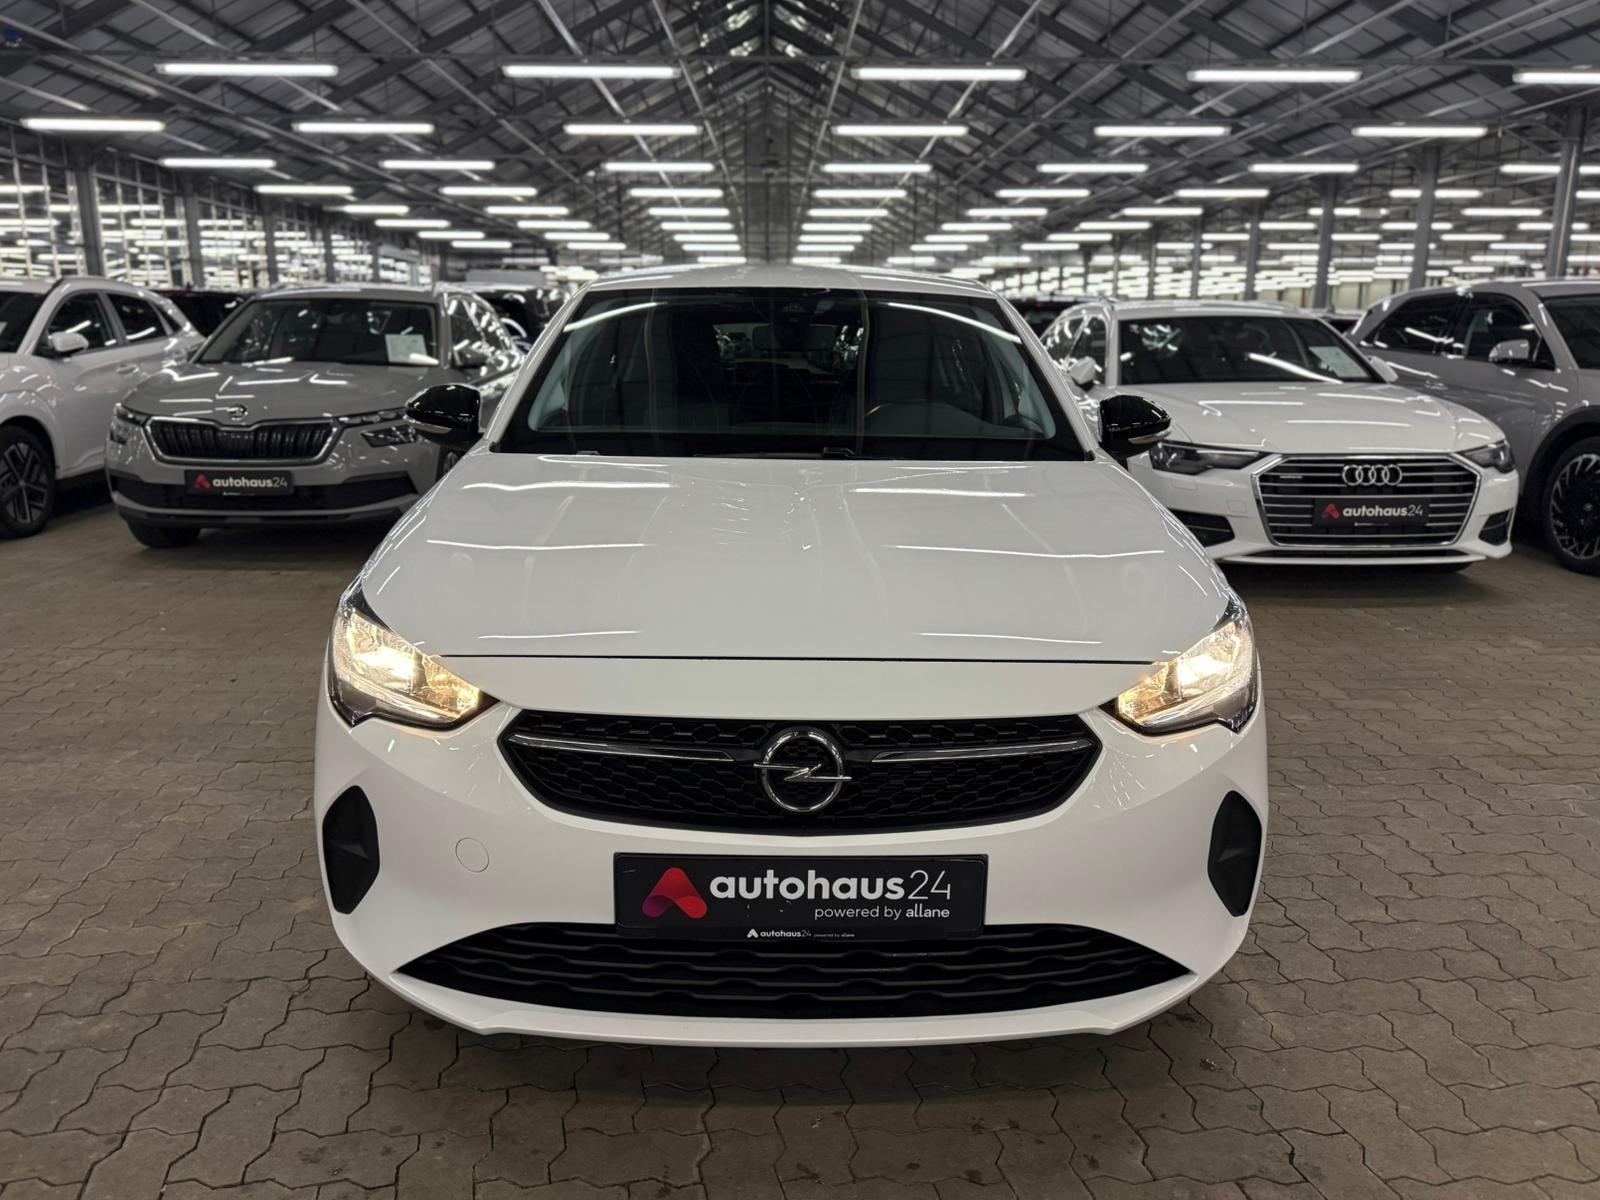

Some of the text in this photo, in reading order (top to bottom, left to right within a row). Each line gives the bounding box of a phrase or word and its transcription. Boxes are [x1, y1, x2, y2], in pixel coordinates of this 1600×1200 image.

[212, 476, 288, 488] autohaus24
[1342, 504, 1424, 517] autohaus24
[709, 869, 951, 900] autohaus24
[814, 904, 950, 920] powered by allane
[760, 929, 812, 938] autohaus24
